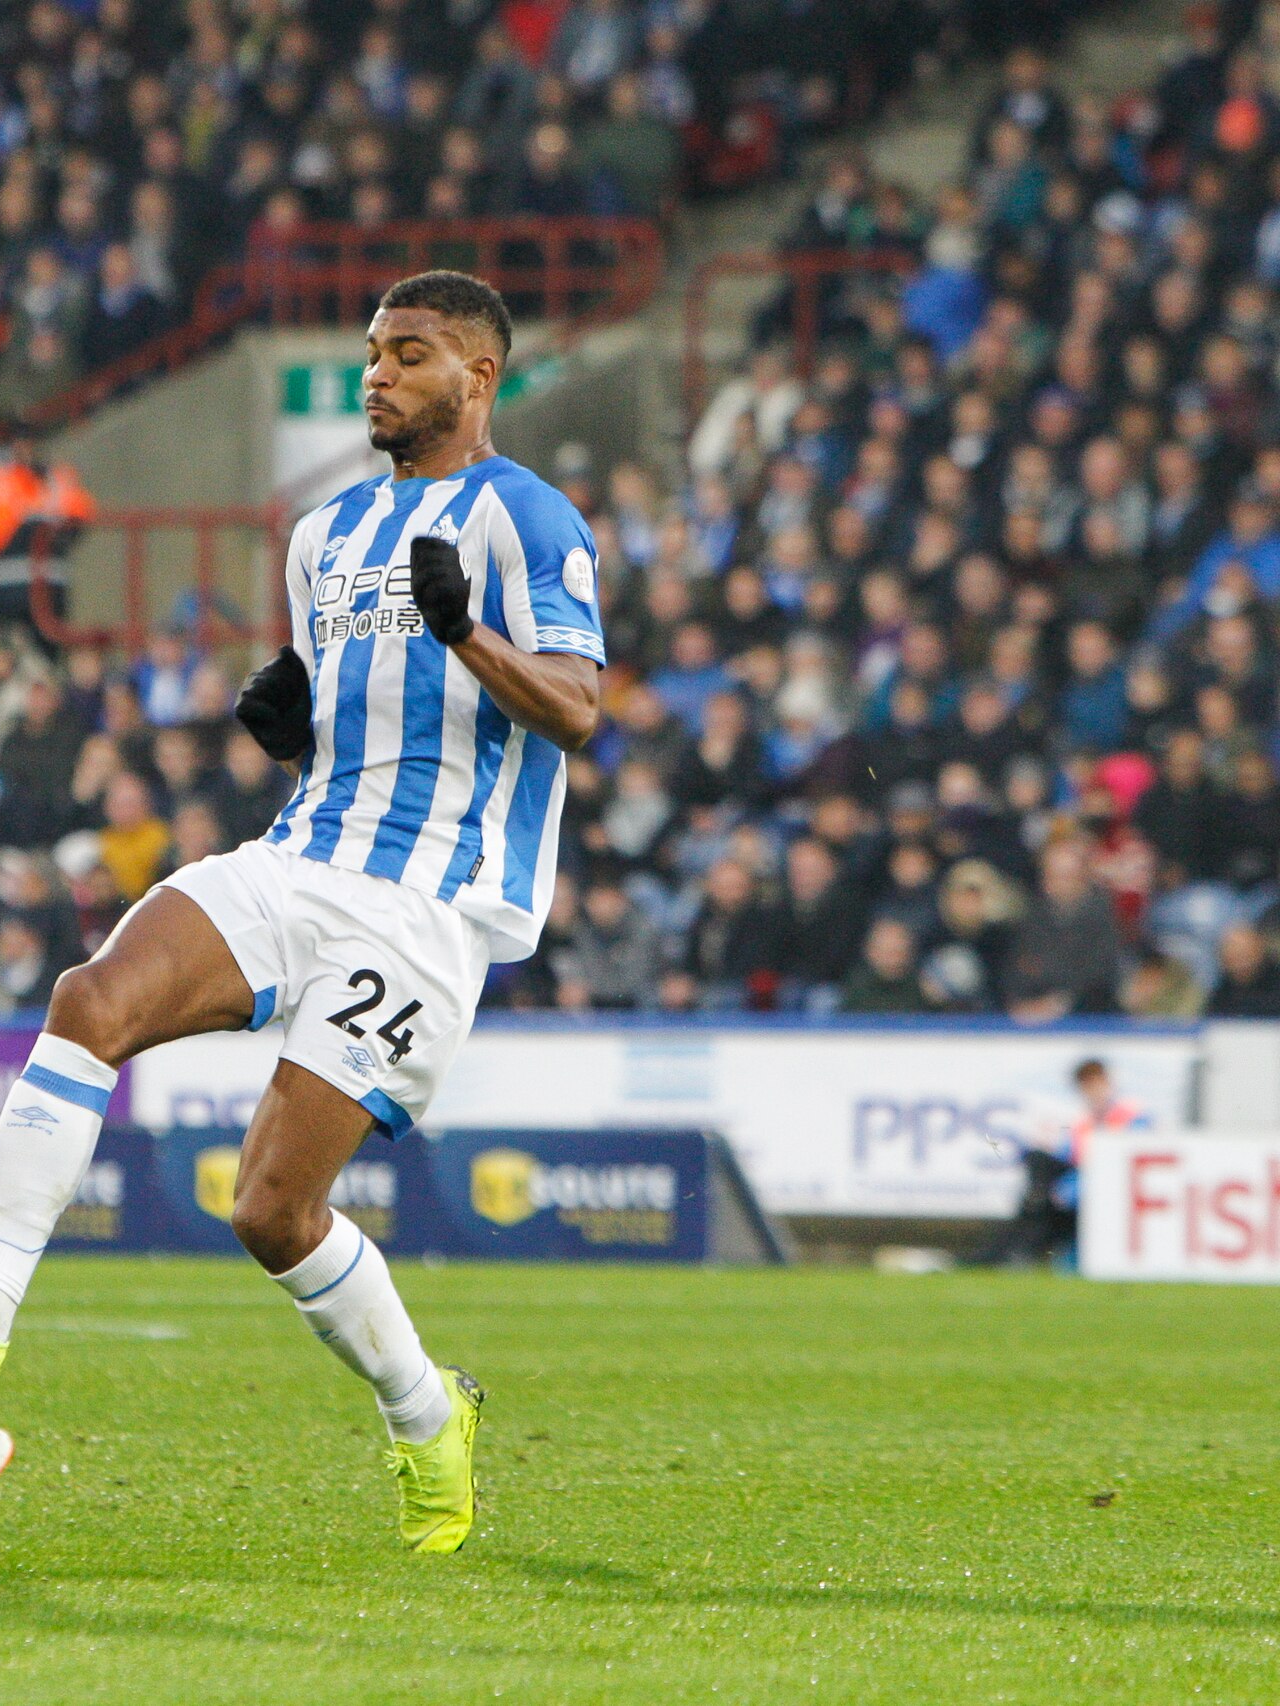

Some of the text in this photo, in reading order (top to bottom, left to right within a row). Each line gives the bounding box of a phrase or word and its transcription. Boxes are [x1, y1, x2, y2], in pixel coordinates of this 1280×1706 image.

[324, 968, 424, 1066] 24
[340, 1055, 369, 1078] umbro
[850, 1095, 1024, 1171] PPS
